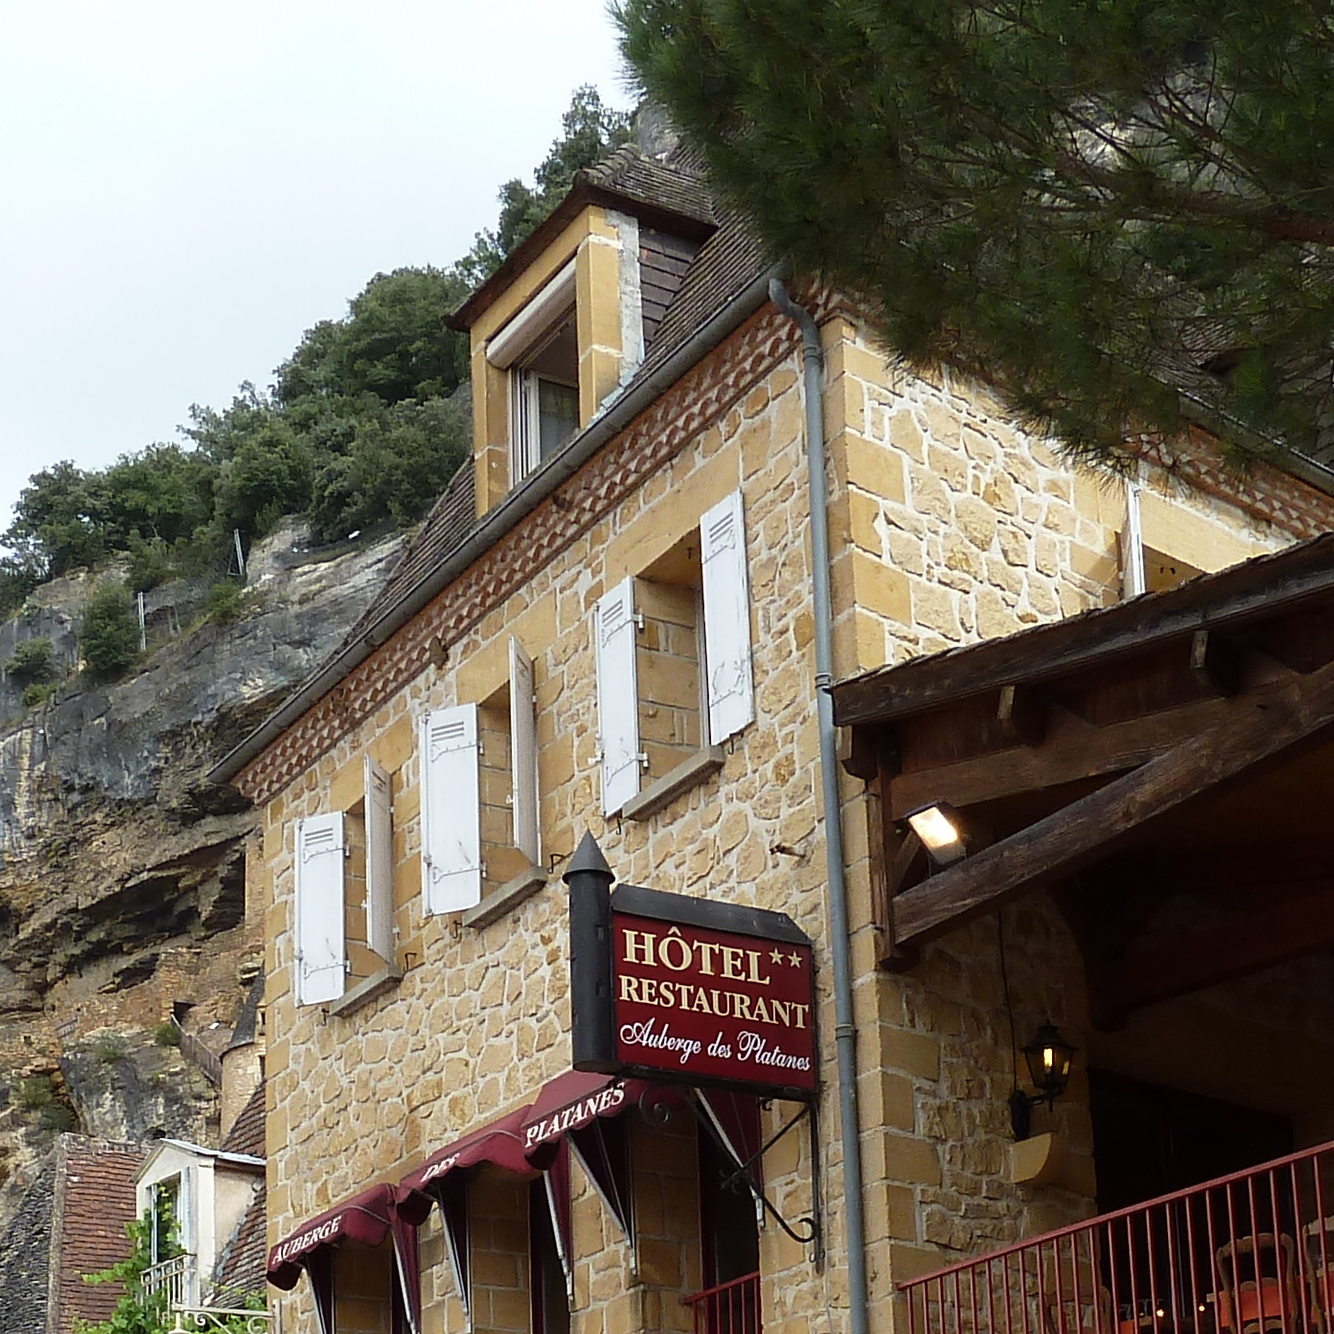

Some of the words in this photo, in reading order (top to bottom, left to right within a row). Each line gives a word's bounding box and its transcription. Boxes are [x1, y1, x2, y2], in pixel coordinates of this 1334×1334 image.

[622, 926, 770, 984] HÔTEL
[618, 975, 809, 1029] RESTAURANT
[620, 1017, 701, 1064] Auberge
[707, 1031, 732, 1058] des
[737, 1031, 811, 1071] Platanes
[272, 1216, 342, 1265] AUBERGE
[524, 1082, 625, 1149] PLATANES
